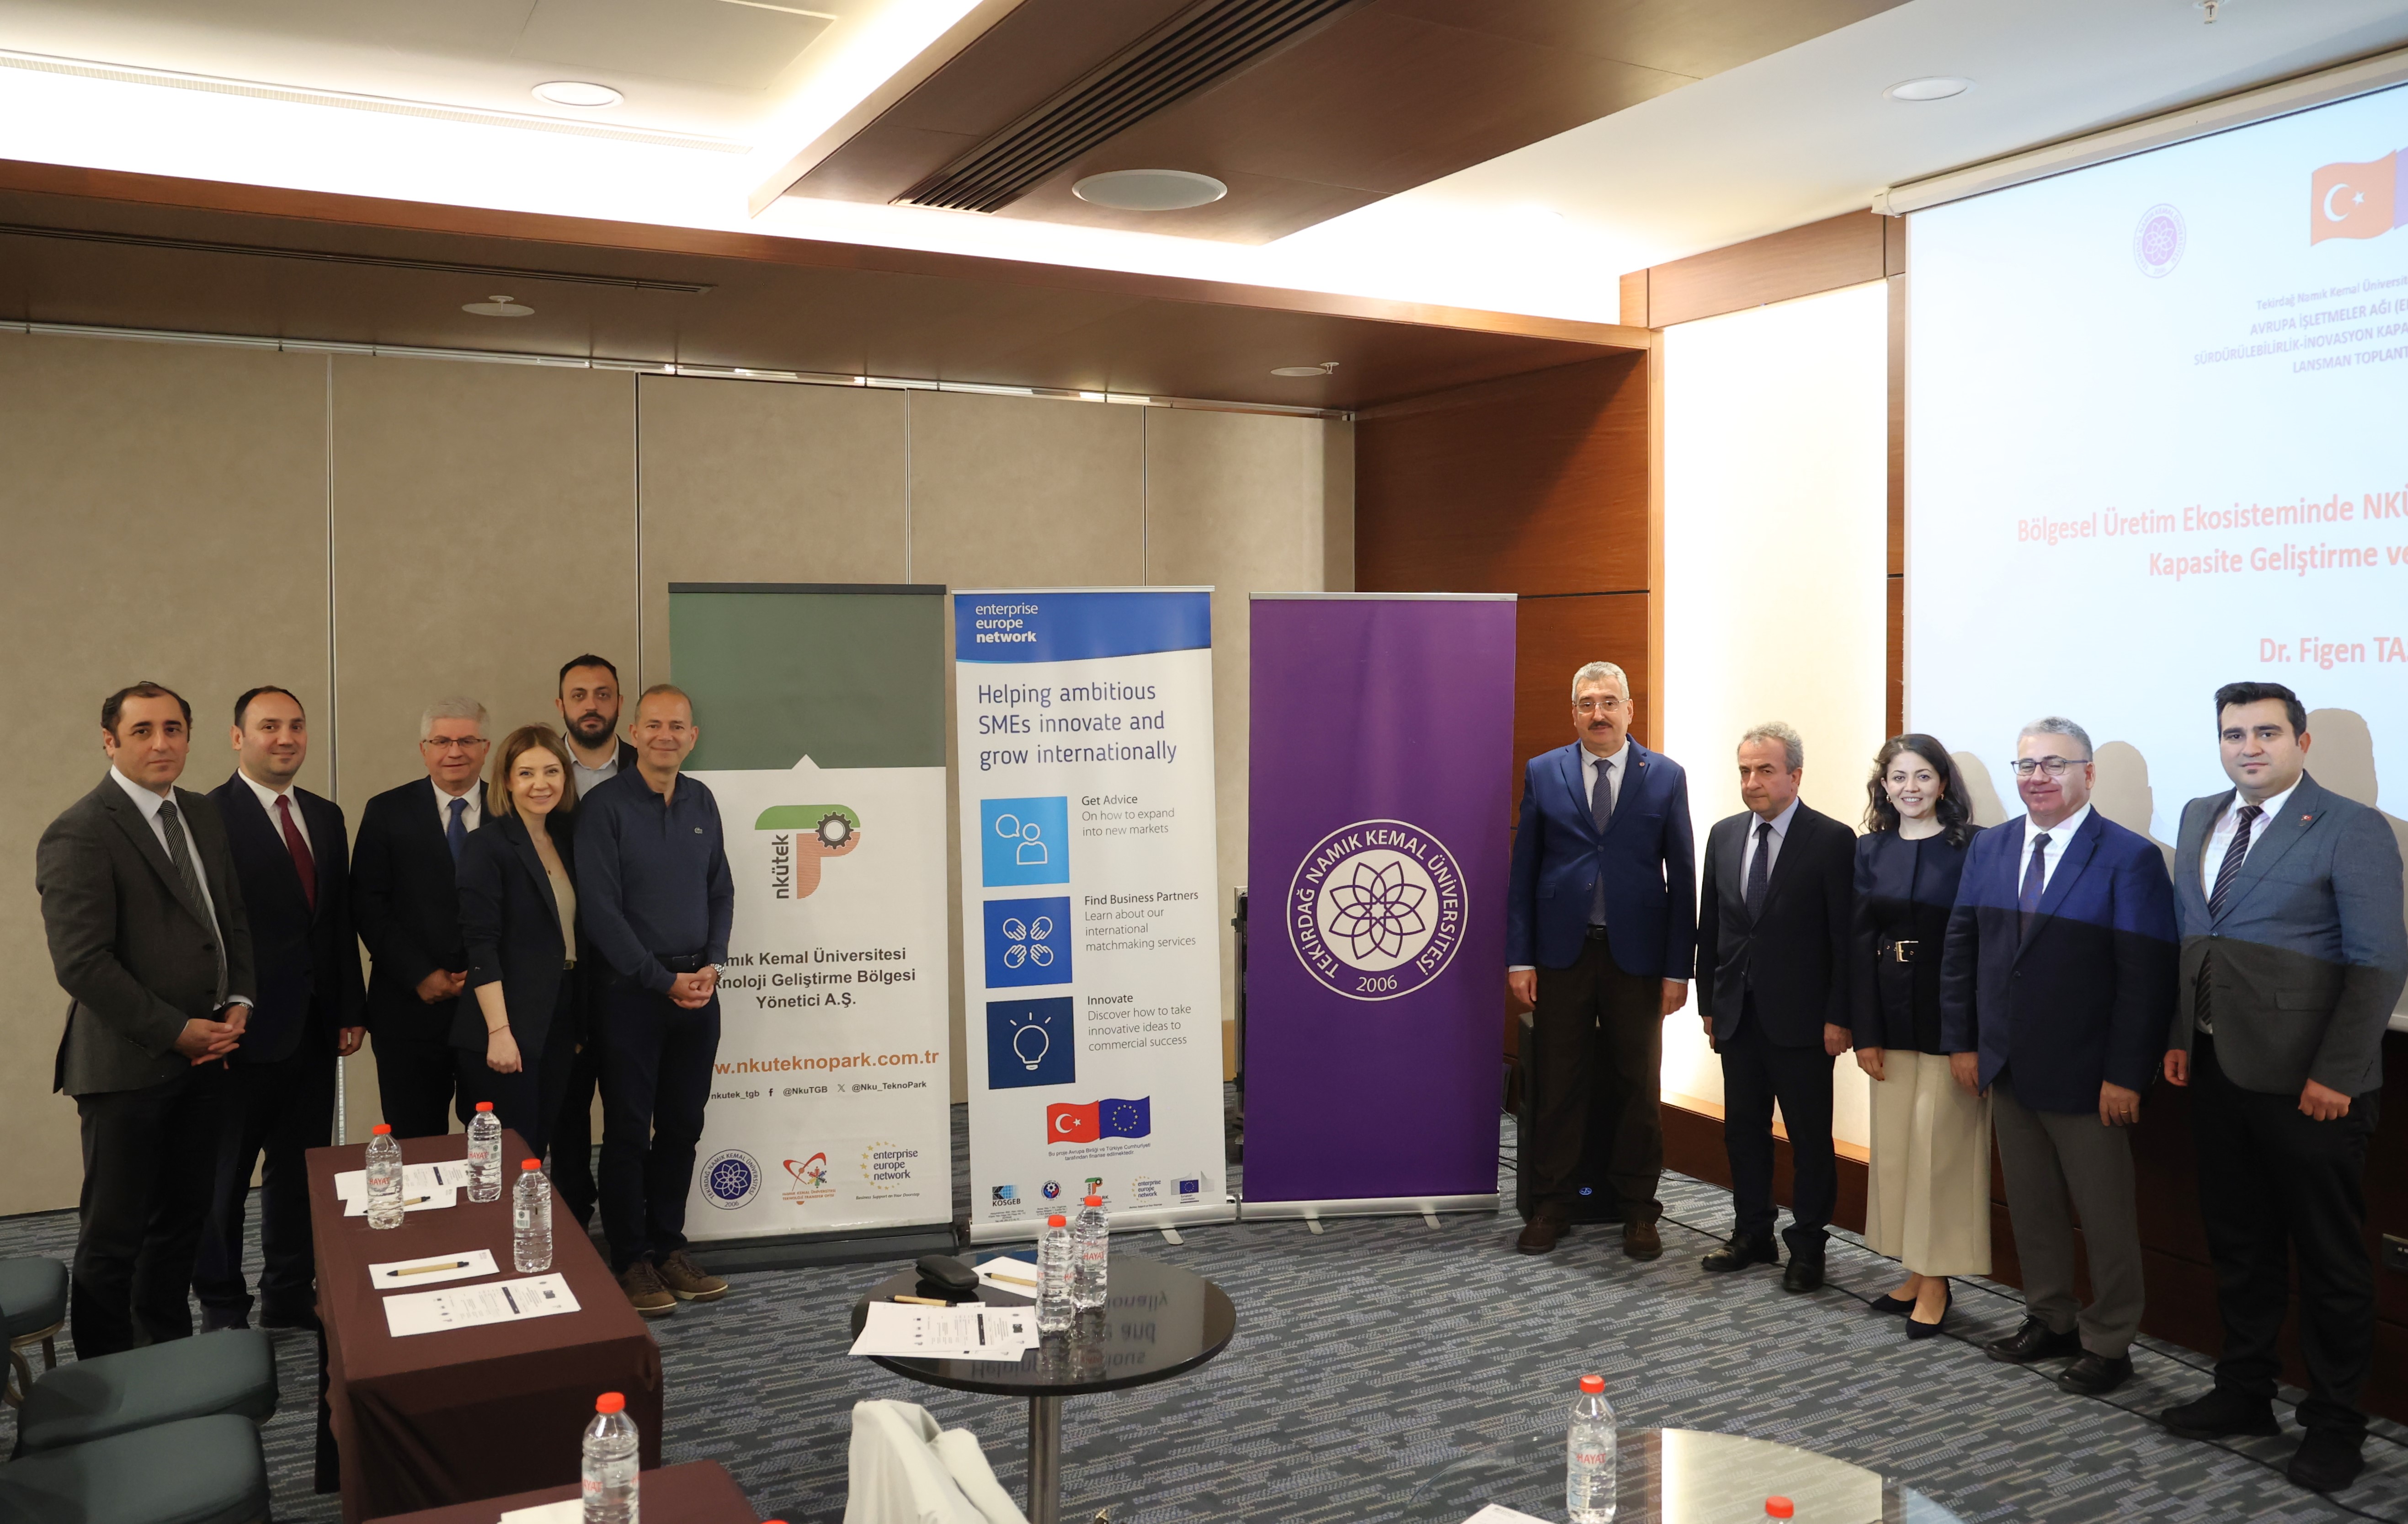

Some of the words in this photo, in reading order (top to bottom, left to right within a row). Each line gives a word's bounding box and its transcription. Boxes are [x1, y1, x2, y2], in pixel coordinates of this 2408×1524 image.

[2257, 294, 2295, 310] Tekirdağ
[2297, 289, 2328, 303] Namık
[2330, 283, 2360, 298] Kemal
[2250, 318, 2296, 336] AVRUPA
[2299, 305, 2366, 331] İŞLETMELER
[2369, 299, 2391, 316] AĞI
[2395, 298, 2408, 315] (E
[2194, 327, 2373, 365] SÜRDÜRÜLEBİLİRLİK-İNOVASYON
[2377, 322, 2408, 339] KAPA
[2293, 357, 2351, 373] LANSMAN
[2355, 346, 2408, 364] TOPLANT
[2018, 513, 2096, 545] Bölgesel
[2104, 507, 2175, 537] Üretim
[2183, 494, 2354, 531] Ekosisteminde
[2149, 549, 2242, 582] Kapasite
[2250, 543, 2378, 577] Geliştirme
[975, 602, 1038, 617] enterprise
[976, 618, 1023, 631] europe
[976, 631, 1037, 643] network
[2260, 638, 2291, 663] Dr.
[2300, 637, 2365, 670] Figen
[2373, 637, 2408, 663] TA
[979, 684, 1051, 708] Helping
[1060, 682, 1156, 701] ambitious
[979, 715, 1030, 734] SMEs
[1040, 714, 1121, 732] innovate
[1130, 711, 1164, 729] and
[980, 749, 1028, 771] grow
[1038, 741, 1177, 764] internationally
[1082, 797, 1100, 805] Get
[1103, 795, 1137, 805] Advice
[1082, 812, 1097, 821] On
[1101, 811, 1122, 820] how
[1125, 811, 1135, 819] to
[1138, 808, 1174, 820] expand
[1082, 827, 1102, 836] into
[1106, 827, 1126, 835] new
[1129, 824, 1168, 834] markets
[1366, 829, 1427, 860] KEMAL
[772, 834, 789, 899] nkütek
[1305, 833, 1363, 884] NAMIK
[1085, 895, 1107, 905] Find
[1110, 893, 1154, 904] Business
[1156, 891, 1199, 901] Partners
[1085, 911, 1112, 921] Learn
[1115, 909, 1144, 920] about
[1147, 908, 1164, 917] our
[1416, 854, 1458, 976] ÜNİVERSİTESİ
[1086, 923, 1148, 936] international
[1296, 888, 1339, 979] TEKİRDAĞ
[1086, 939, 1155, 952] matchmaking
[1157, 936, 1196, 947] services
[726, 953, 754, 966] mık
[759, 951, 808, 965] Kemal
[814, 948, 906, 964] Üniversitesi
[772, 973, 852, 988] Geliştirme
[858, 969, 916, 984] Bölgesi
[1356, 975, 1397, 992] 2006
[756, 994, 820, 1009] Yönetici
[825, 992, 856, 1008] A.Ş.
[1087, 994, 1133, 1005] Innovate
[1088, 1010, 1131, 1021] Discover
[1134, 1008, 1155, 1018] how
[1158, 1007, 1168, 1016] to
[1171, 1005, 1191, 1015] take
[1088, 1024, 1140, 1036] innovative
[1142, 1021, 1168, 1032] ideas
[1171, 1020, 1181, 1030] to
[1089, 1038, 1147, 1051] commercial
[1150, 1036, 1187, 1046] success
[713, 1051, 939, 1075] w.nkuteknopark.com.tr
[783, 1086, 828, 1096] @NkuTGB
[852, 1081, 927, 1092] @Nku_TeknoPark
[708, 1155, 725, 1170] NAMIK
[873, 1150, 918, 1159] enterprise
[874, 1160, 905, 1171] europe
[874, 1170, 911, 1181] network
[992, 1198, 1021, 1207] KOSGEB
[1083, 1251, 1105, 1260] HAYAT
[1576, 1453, 1606, 1464] HAYAT
[583, 1479, 602, 1492] AYAT
